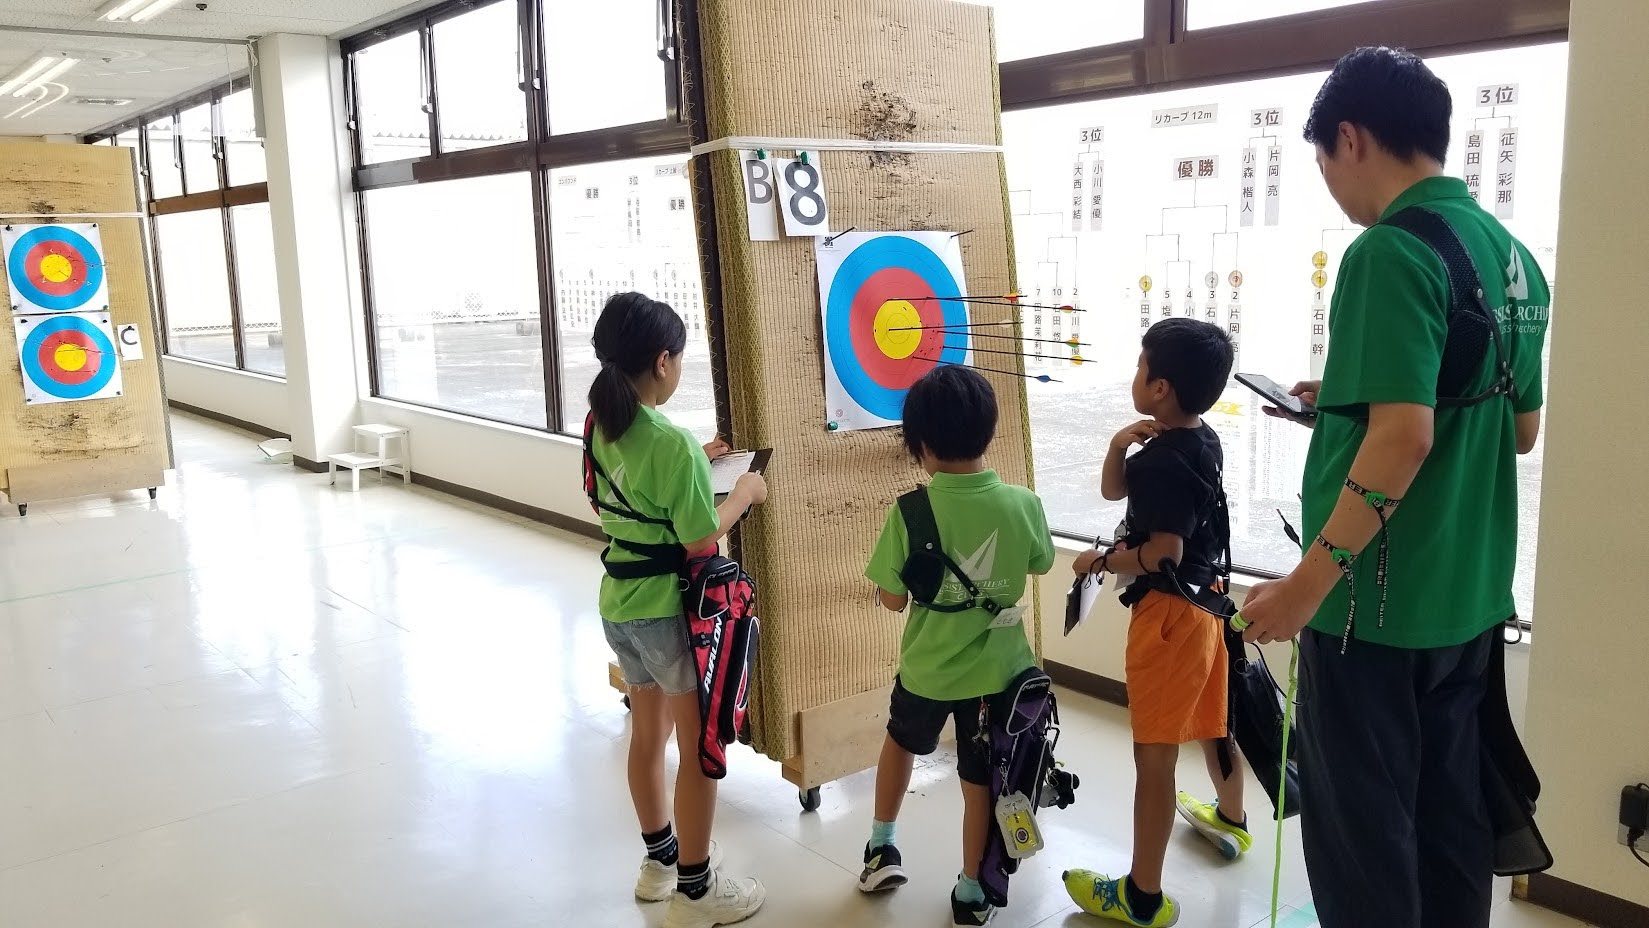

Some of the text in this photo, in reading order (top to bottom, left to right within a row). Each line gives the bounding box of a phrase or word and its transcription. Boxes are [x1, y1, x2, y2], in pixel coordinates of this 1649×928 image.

[1480, 86, 1514, 105] 3位
[1155, 110, 1212, 125] リカーブ 12m
[1253, 109, 1280, 126] 3位
[1081, 128, 1102, 143] 3位
[1177, 158, 1214, 179] 優勝
[745, 159, 773, 205] B
[784, 161, 826, 227] 8
[1052, 288, 1062, 296] 10
[1164, 290, 1170, 299] 5
[1186, 290, 1192, 298] 4
[1209, 290, 1215, 299] 3
[1232, 291, 1238, 300] 2
[120, 327, 138, 346] C
[703, 615, 723, 695] AVALON
